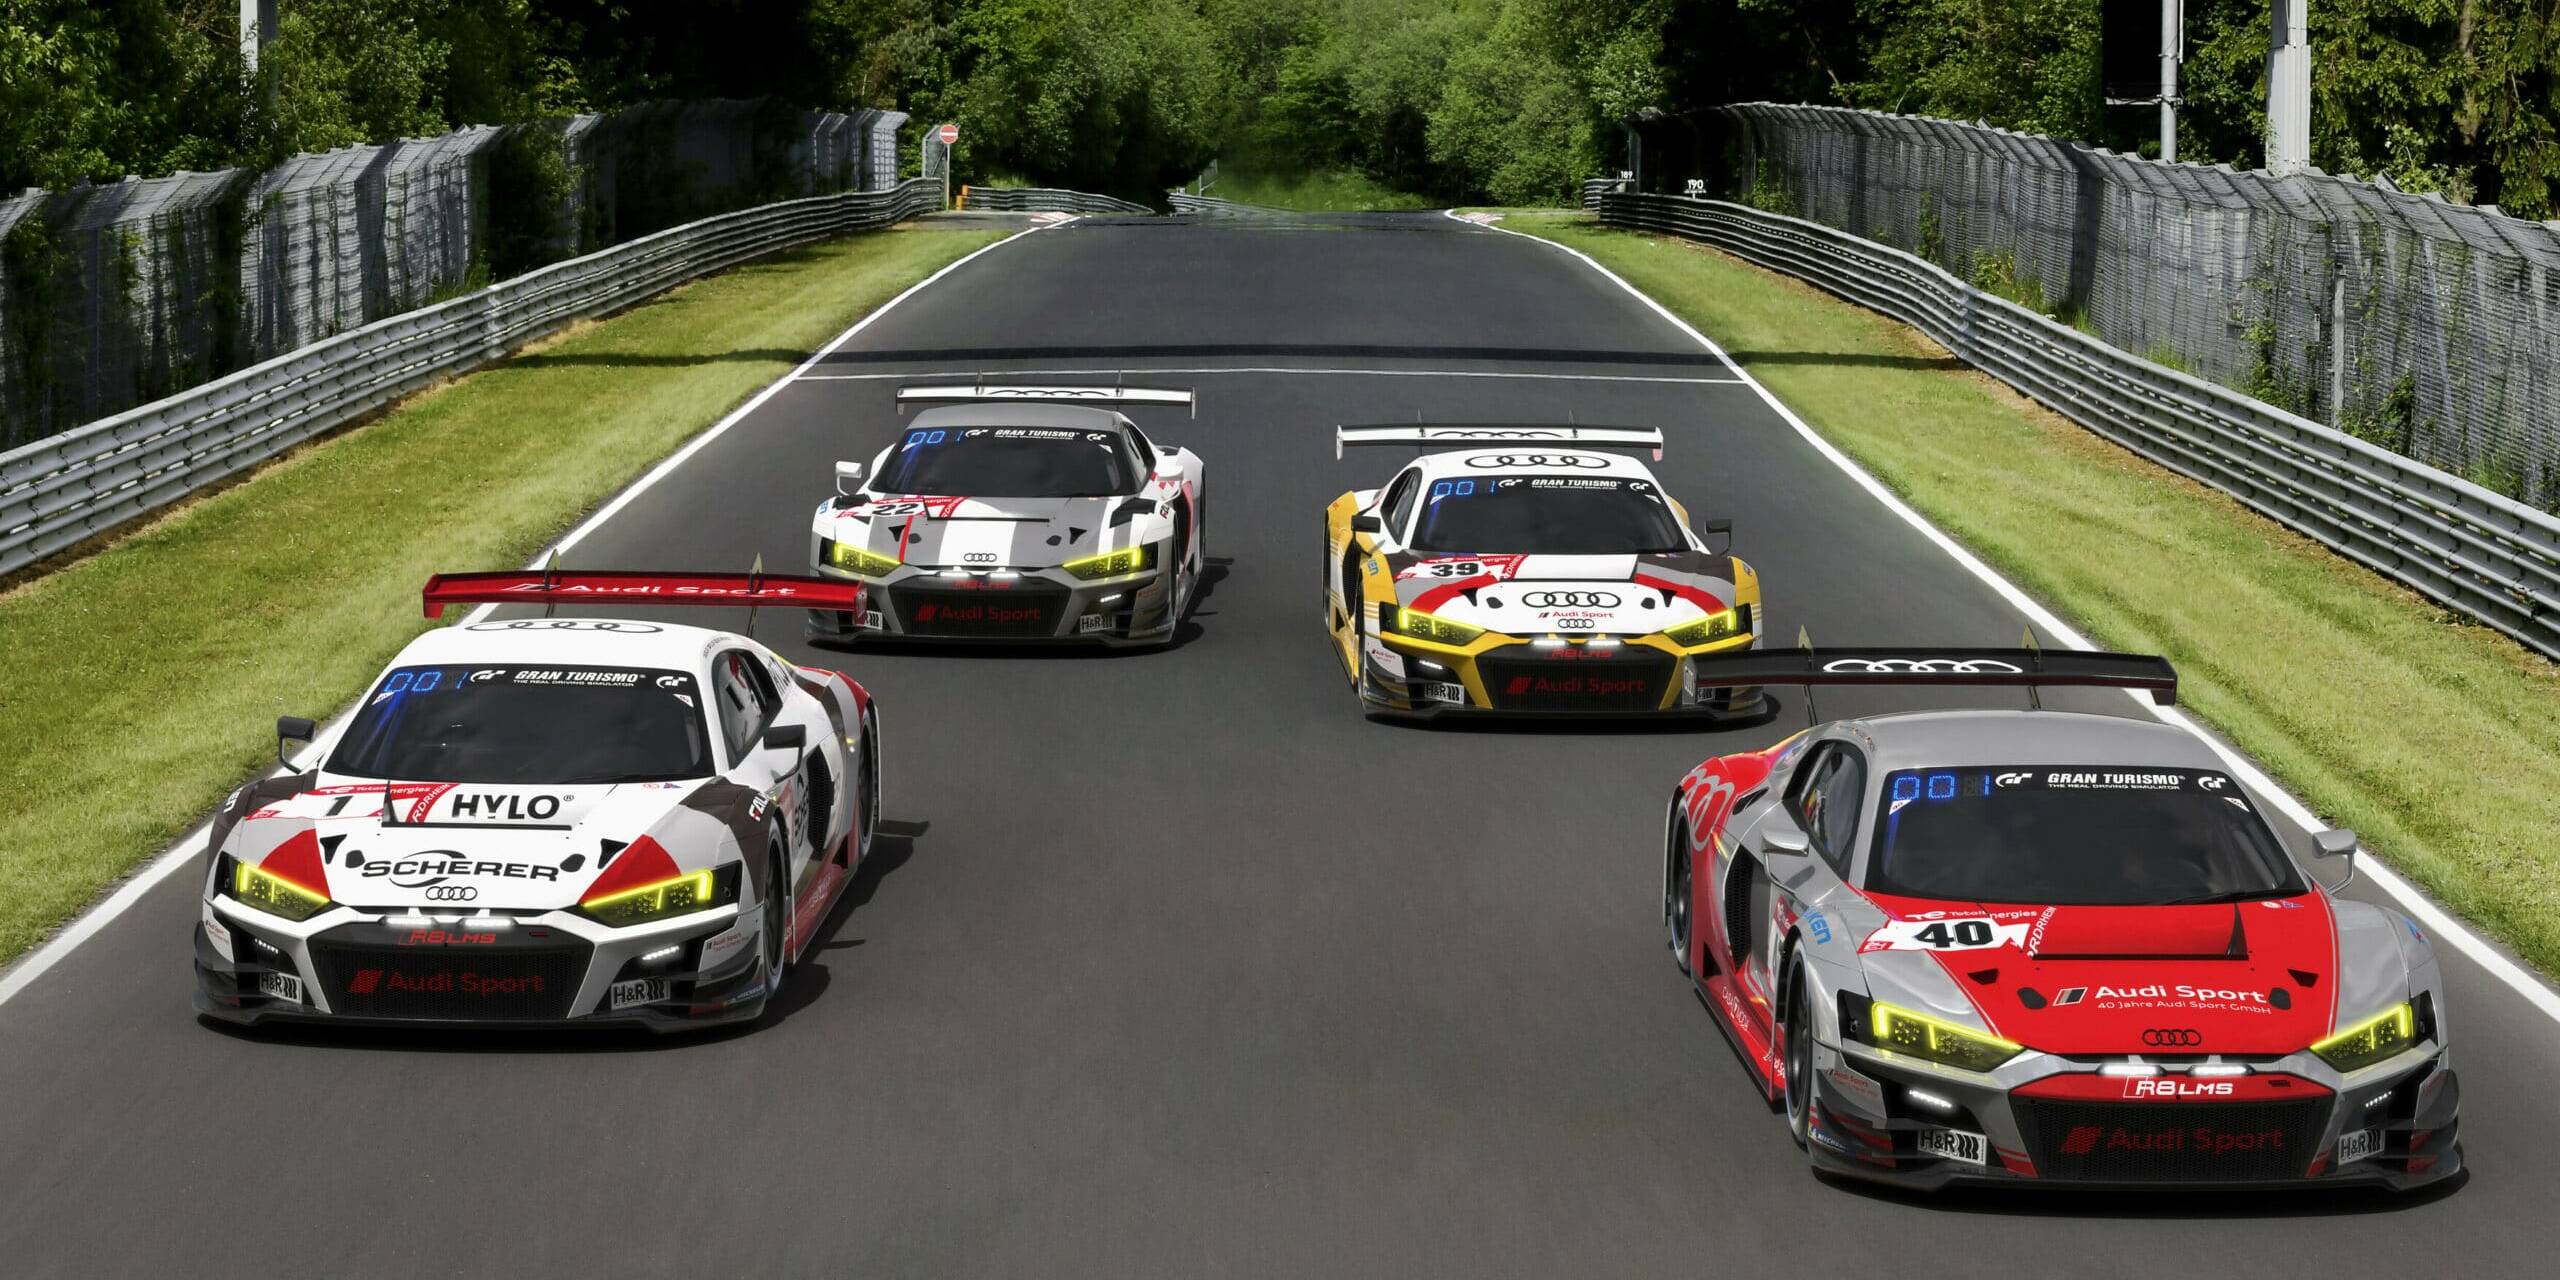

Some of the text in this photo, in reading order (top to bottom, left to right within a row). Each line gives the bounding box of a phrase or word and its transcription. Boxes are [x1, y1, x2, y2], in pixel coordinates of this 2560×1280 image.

[1687, 179, 1704, 190] 190
[994, 429, 1026, 437] GRAN
[1531, 479, 1565, 487] GRAN
[872, 503, 919, 516] 22
[1431, 562, 1479, 577] 39
[562, 585, 796, 597] Audi Sport
[940, 606, 1041, 624] Audi Sport
[1581, 611, 1615, 619] Sport
[514, 670, 639, 683] GRAN TURISMO
[1535, 677, 1645, 695] Audi Sport
[2047, 773, 2179, 785] GRAN TURISMO
[361, 859, 560, 882] SCHERER
[409, 928, 497, 944] R8 LMS
[1912, 920, 1994, 948] 40
[260, 971, 283, 994] H&R
[385, 970, 545, 997] Audi Sport
[613, 982, 647, 1004] H&R
[2095, 984, 2268, 1004] Audi Sport
[2097, 1000, 2273, 1015] 40 Jahre Audi Sport GmbH
[2136, 1080, 2234, 1096] R8 LMS
[1920, 1128, 1956, 1153] H&R
[2107, 1127, 2285, 1155] Audi Sport
[2340, 1135, 2367, 1159] H&R
